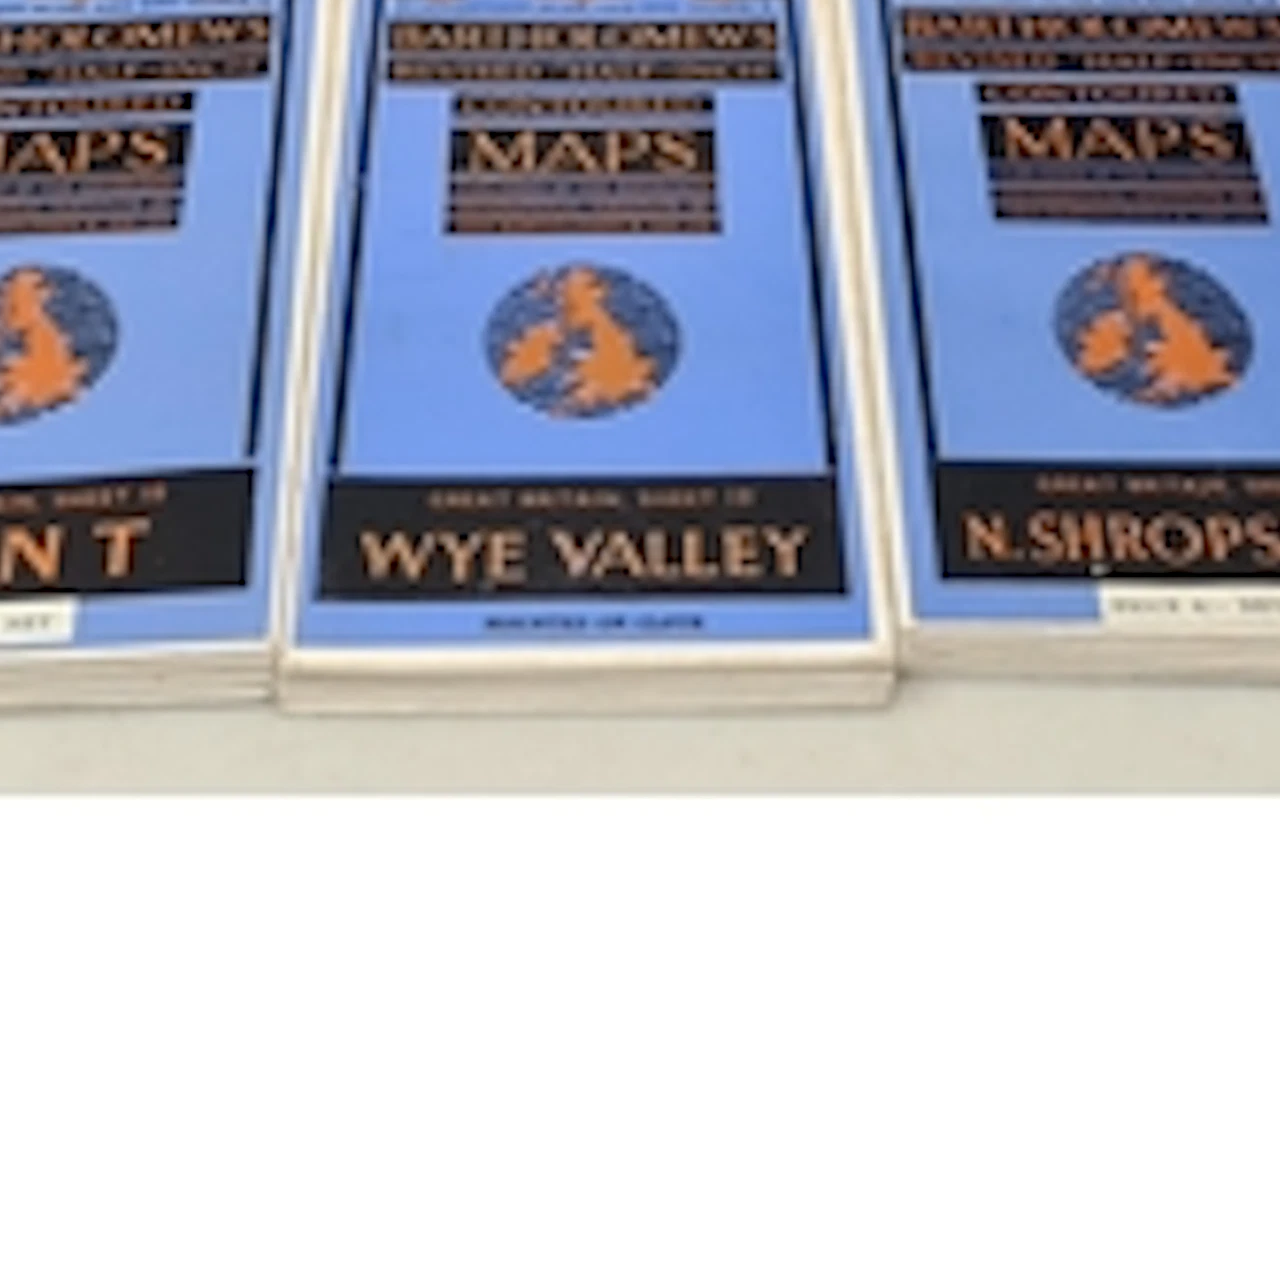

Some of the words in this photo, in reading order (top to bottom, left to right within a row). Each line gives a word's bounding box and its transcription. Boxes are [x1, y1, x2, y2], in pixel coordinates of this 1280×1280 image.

[469, 131, 697, 172] MAPS
[1002, 116, 1236, 162] MAPS
[359, 528, 527, 584] WYE
[552, 525, 810, 579] VALLEY
